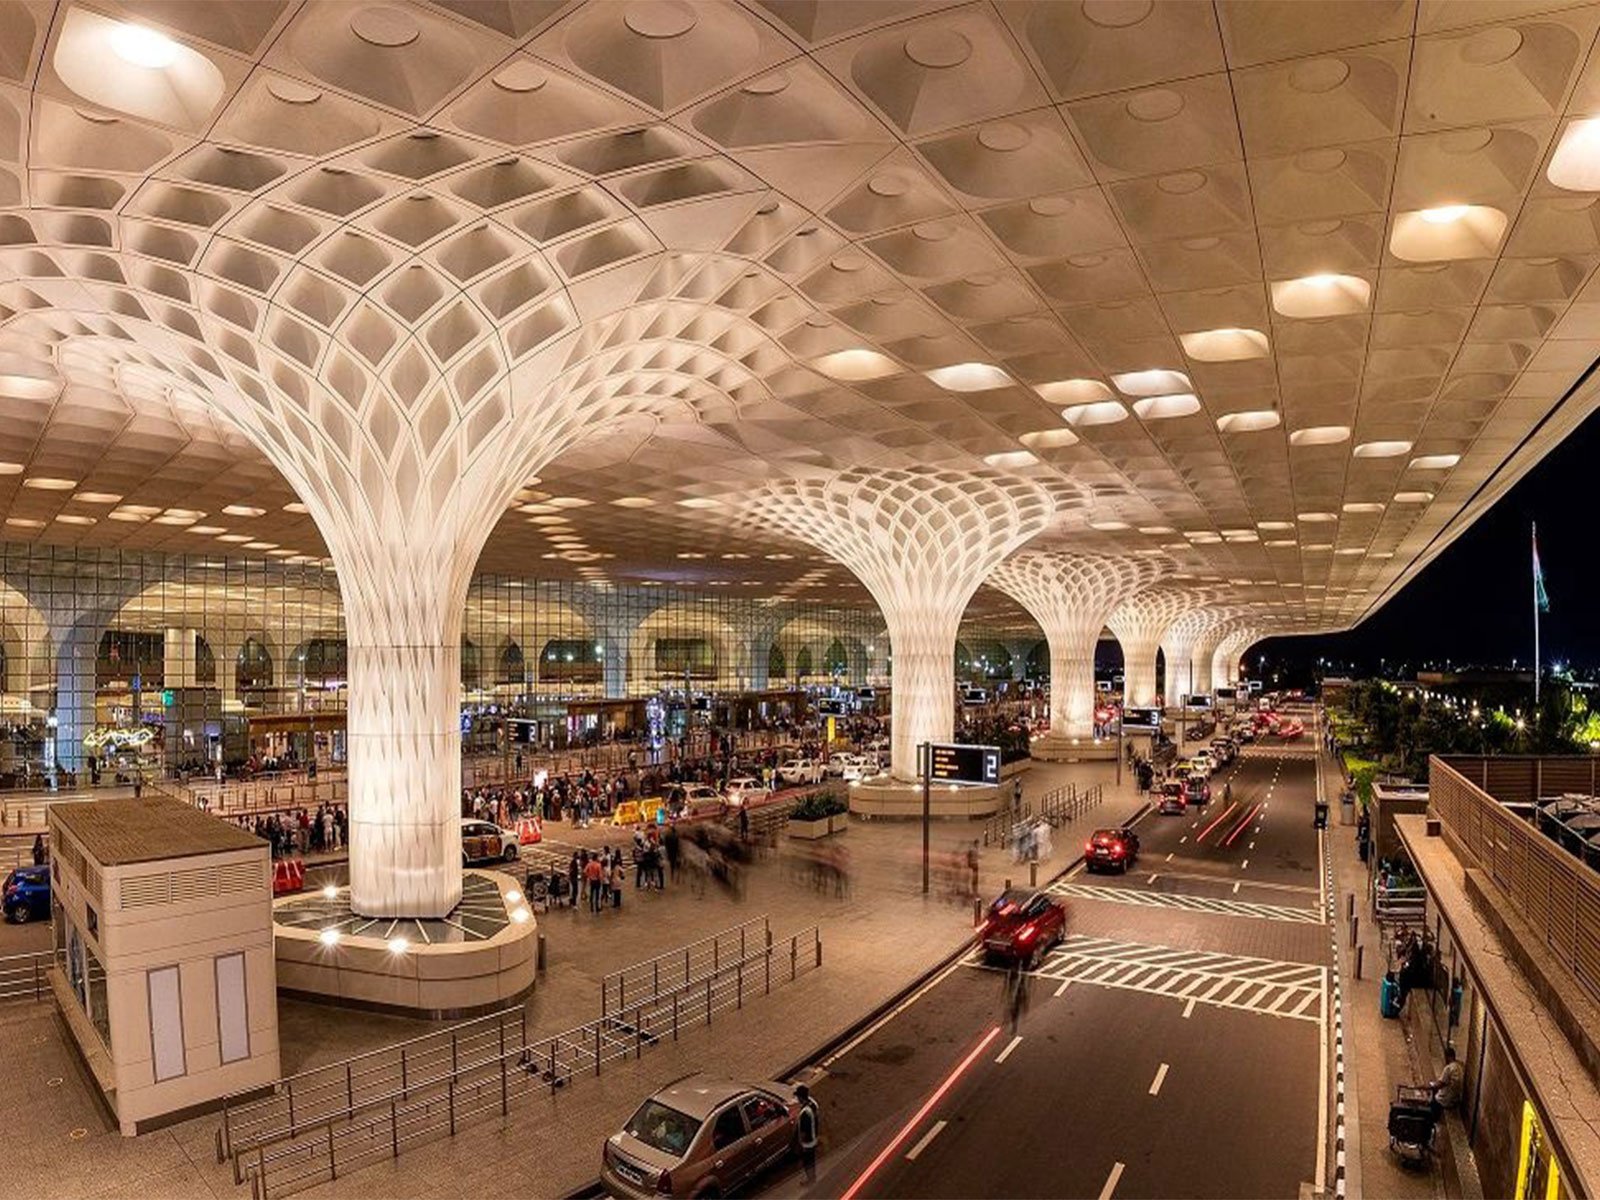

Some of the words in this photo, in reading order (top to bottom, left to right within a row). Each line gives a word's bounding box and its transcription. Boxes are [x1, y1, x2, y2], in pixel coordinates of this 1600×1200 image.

[1151, 711, 1158, 725] 3
[530, 726, 535, 741] 2
[987, 755, 996, 777] 2
